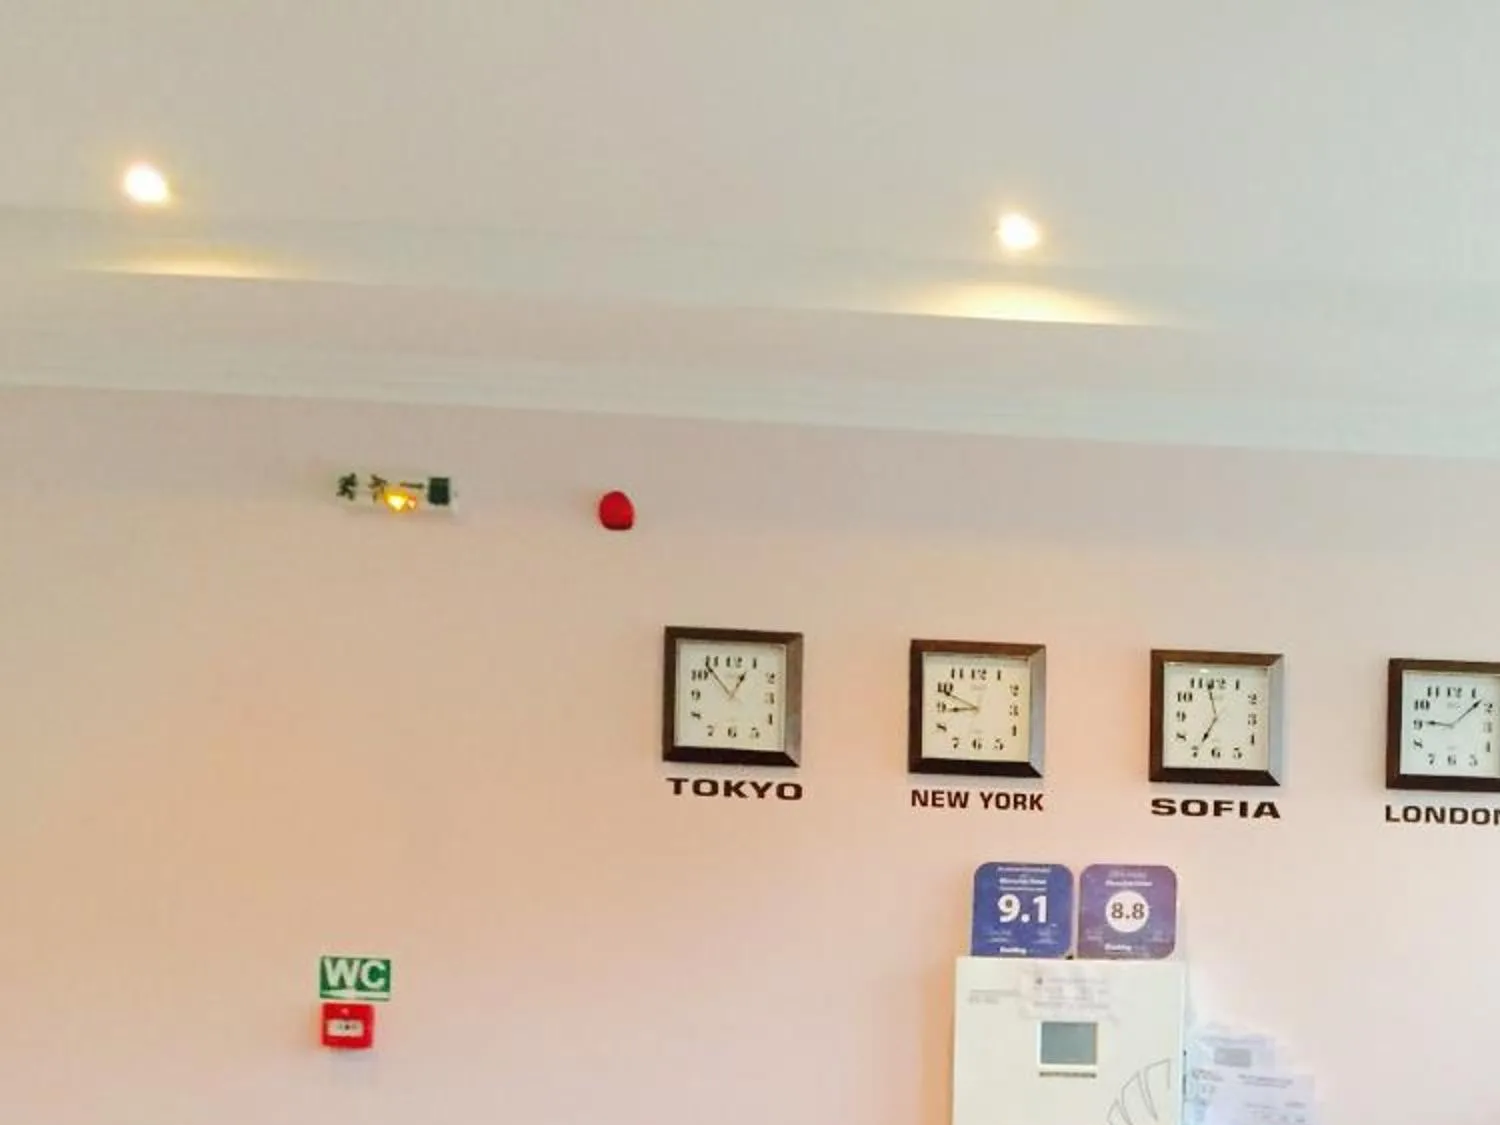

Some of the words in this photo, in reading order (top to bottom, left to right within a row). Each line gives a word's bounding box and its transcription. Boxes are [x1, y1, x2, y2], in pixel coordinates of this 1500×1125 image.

[726, 655, 743, 669] 12
[765, 672, 775, 684] 2
[951, 668, 964, 680] 11
[971, 668, 987, 681] 12
[1190, 677, 1203, 689] 11
[1009, 684, 1019, 697] 2
[1177, 691, 1193, 702] 10
[1427, 686, 1439, 698] 11
[1447, 686, 1462, 698] 12
[1248, 693, 1257, 705] 2
[1414, 700, 1430, 710] 10
[1484, 703, 1493, 714] 2
[666, 777, 803, 801] TOKYO
[911, 789, 970, 809] NEW
[979, 791, 1044, 811] YORK
[1151, 798, 1281, 819] SOFIA
[997, 893, 1047, 923] 9.1
[1111, 902, 1145, 920] 8.8
[323, 957, 387, 989] WC
